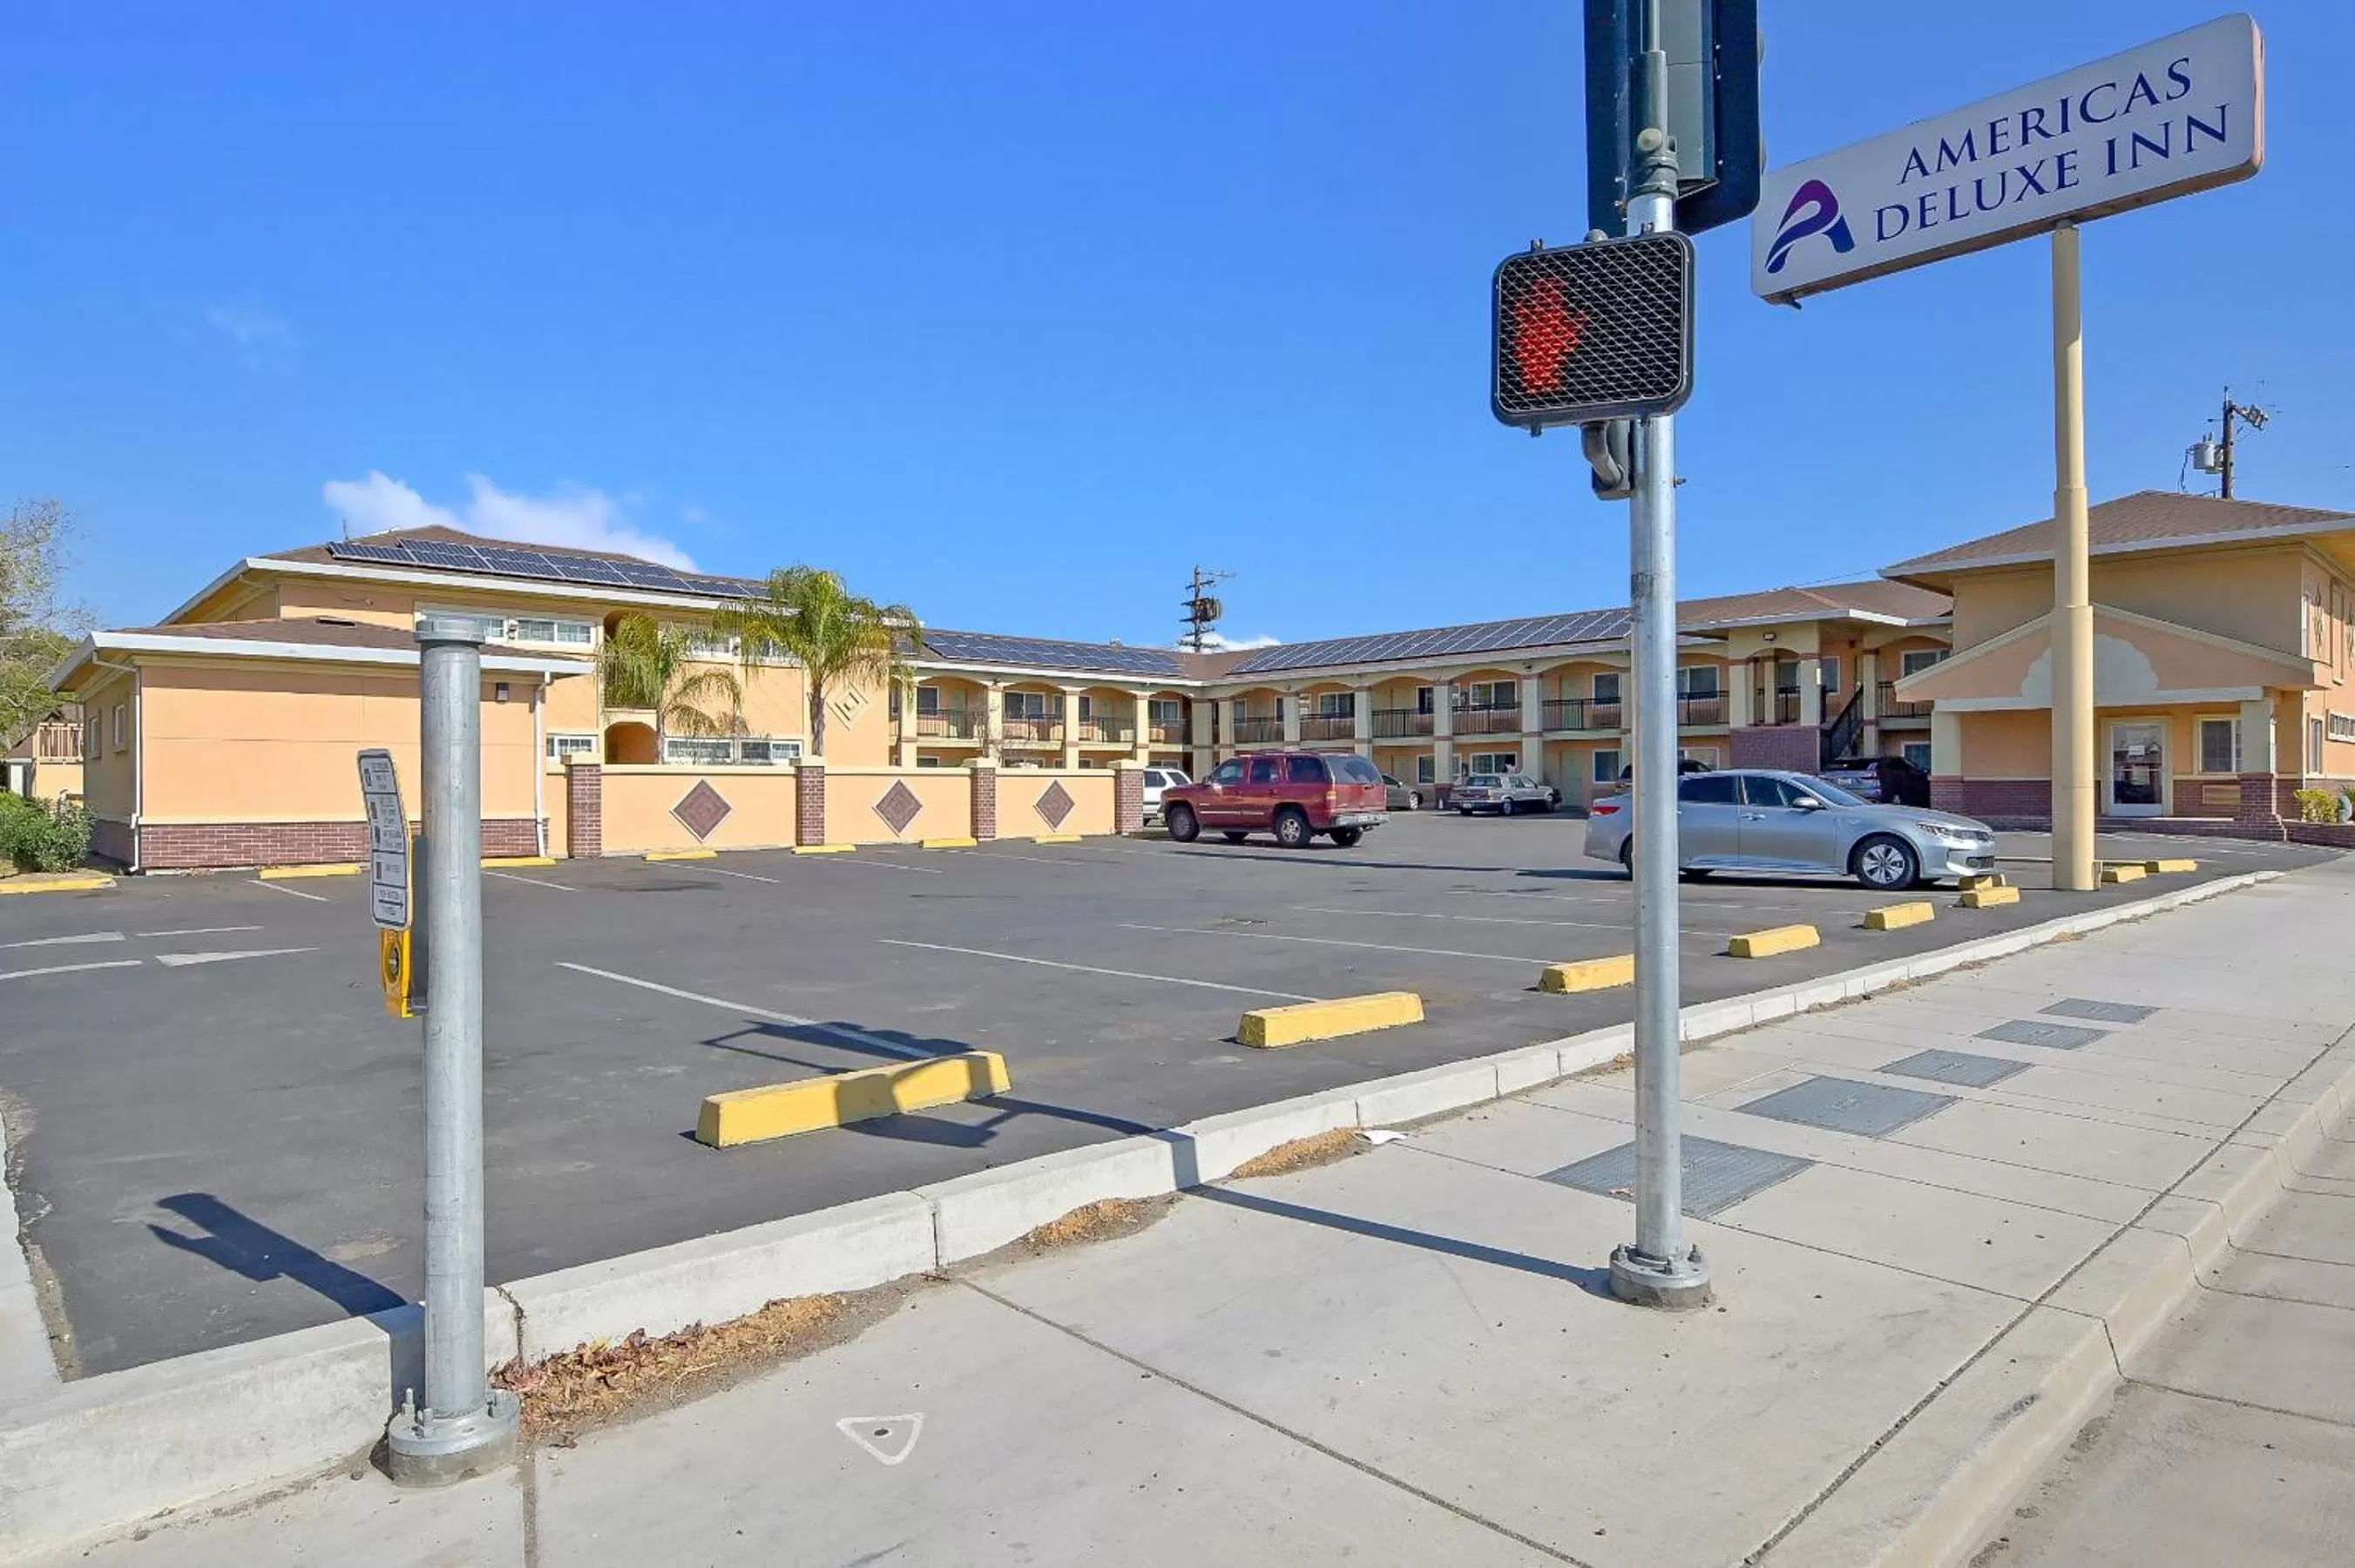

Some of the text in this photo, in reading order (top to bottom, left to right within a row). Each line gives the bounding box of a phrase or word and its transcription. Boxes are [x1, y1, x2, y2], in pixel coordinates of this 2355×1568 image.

[1873, 103, 2231, 244] DELUXE INN
[1898, 57, 2192, 186] AMERICAS
